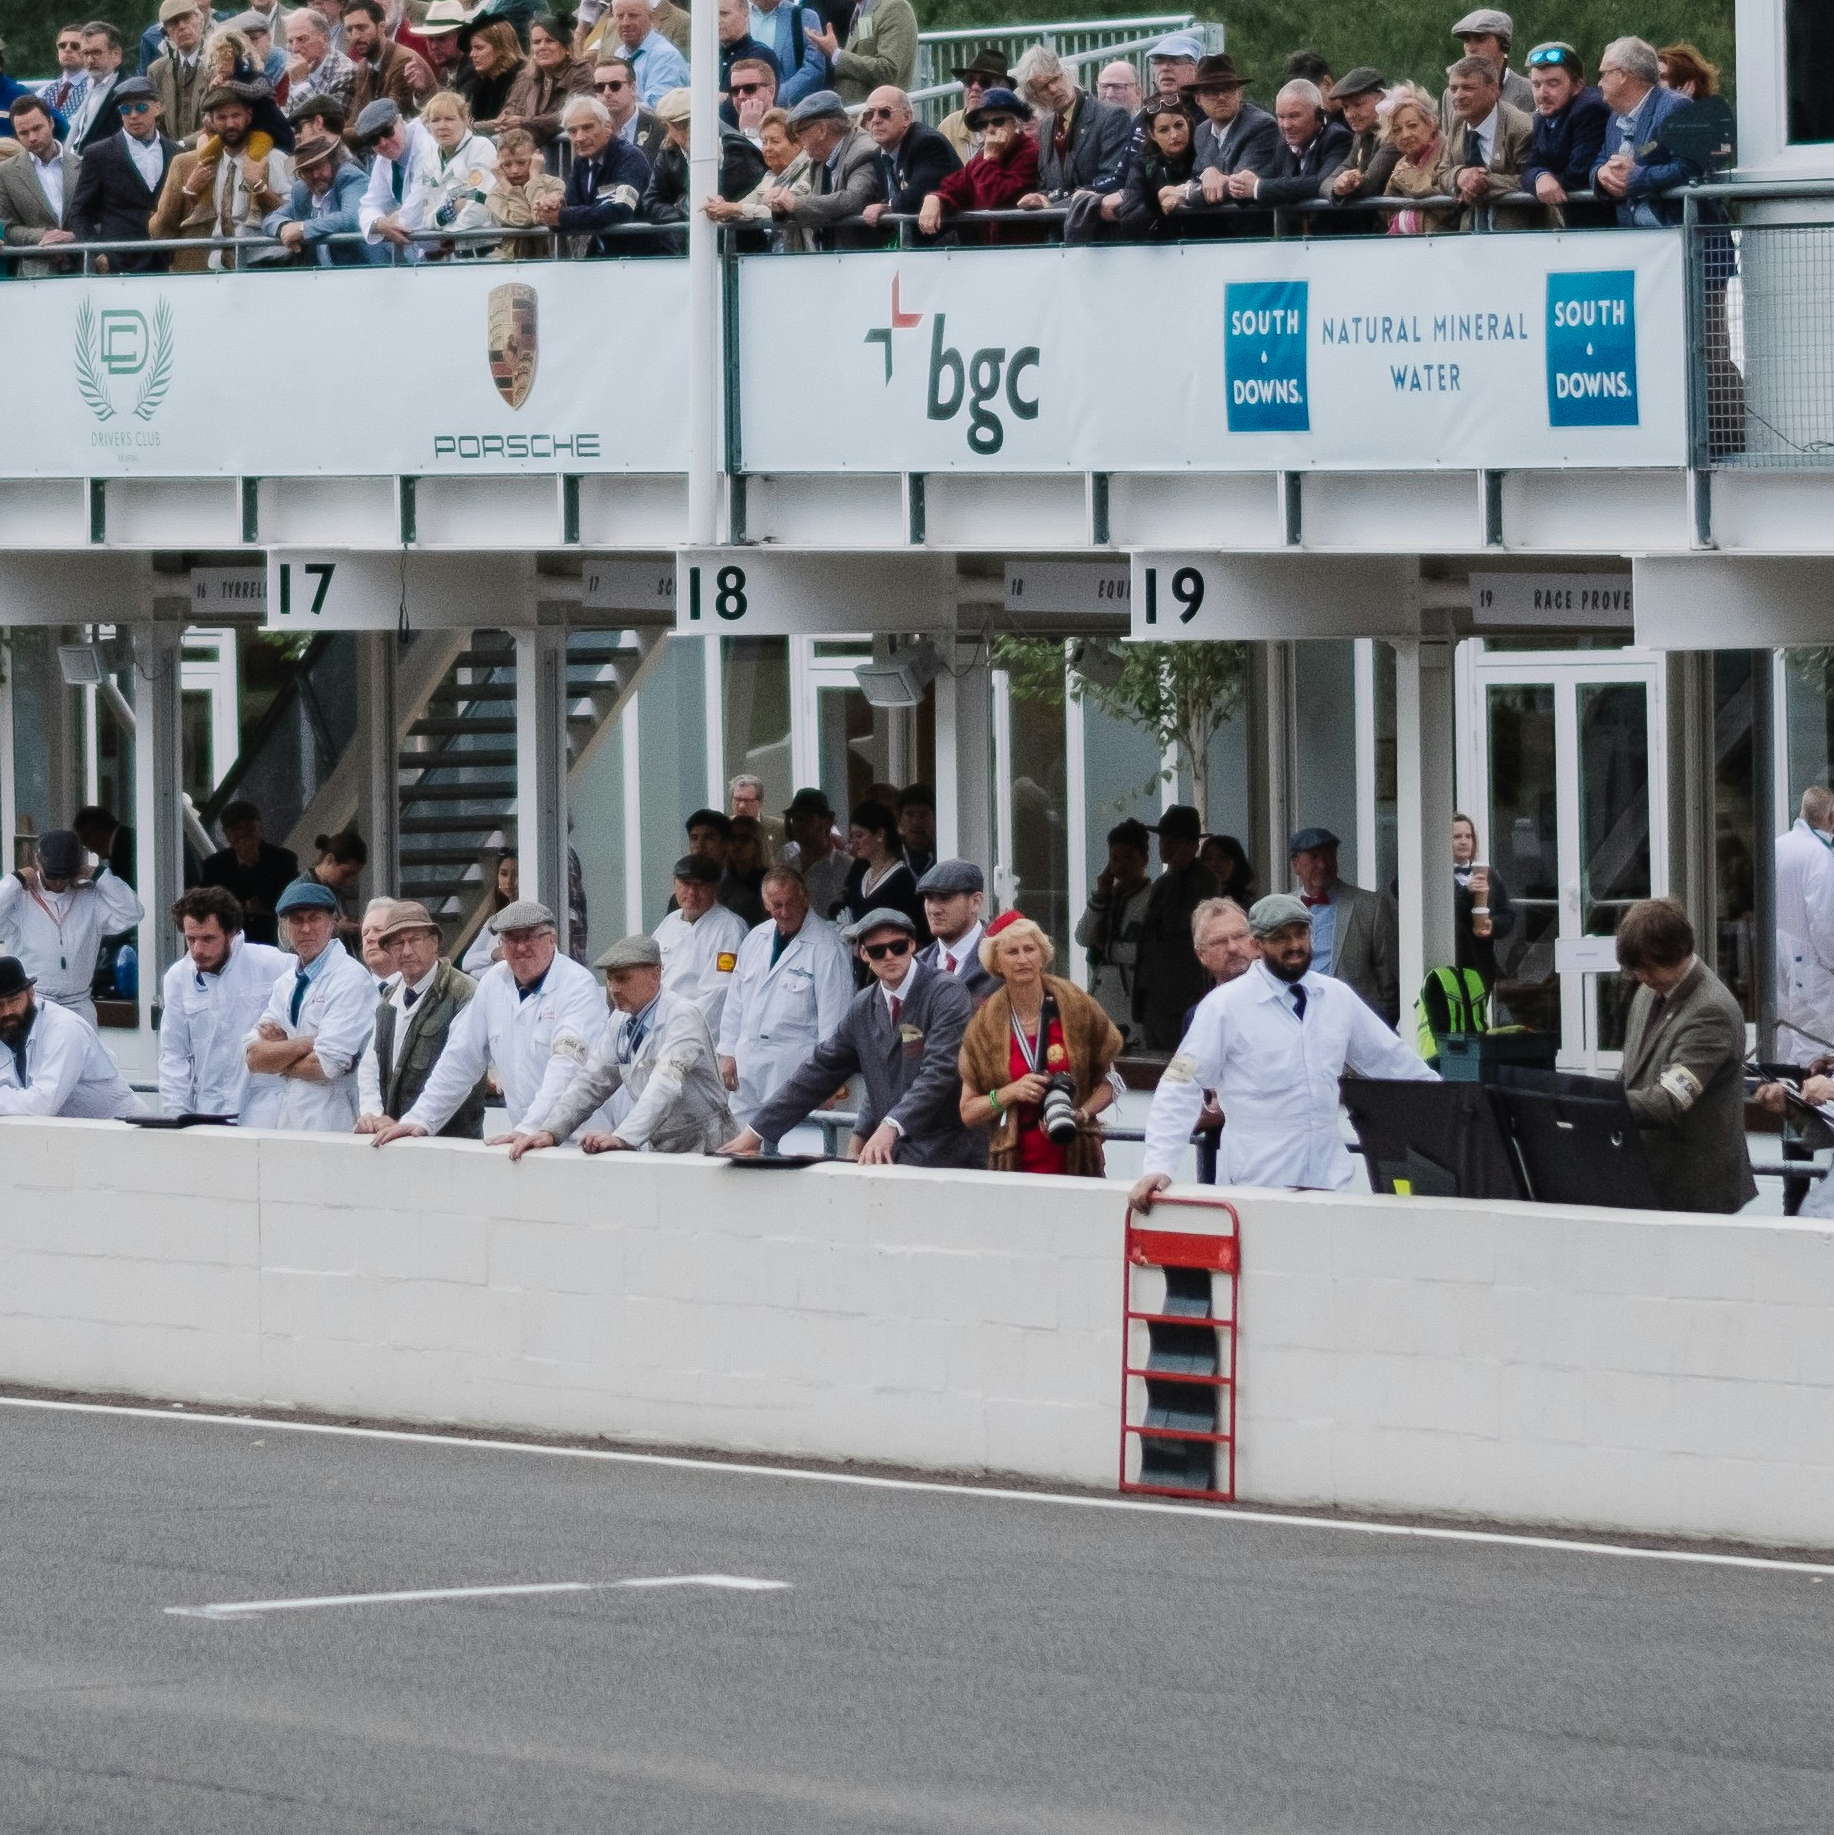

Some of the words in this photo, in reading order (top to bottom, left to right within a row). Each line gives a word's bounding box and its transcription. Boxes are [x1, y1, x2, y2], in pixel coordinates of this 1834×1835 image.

[1231, 308, 1300, 336] SOUTH
[1322, 316, 1422, 344] NATURAL
[1433, 312, 1529, 342] MINERAL
[1554, 299, 1626, 328] SOUTH
[927, 313, 1041, 455] bgc
[1390, 363, 1461, 392] WATER
[90, 431, 133, 447] DRIVERS
[135, 431, 162, 447] CLUB
[434, 433, 601, 459] PORSCHE
[280, 564, 335, 614] 17
[657, 577, 676, 596] SC
[690, 566, 747, 620] 18
[1146, 567, 1204, 623] 19
[1480, 590, 1494, 608] 19
[1533, 589, 1573, 610] RACE
[1581, 590, 1631, 611] PROVE
